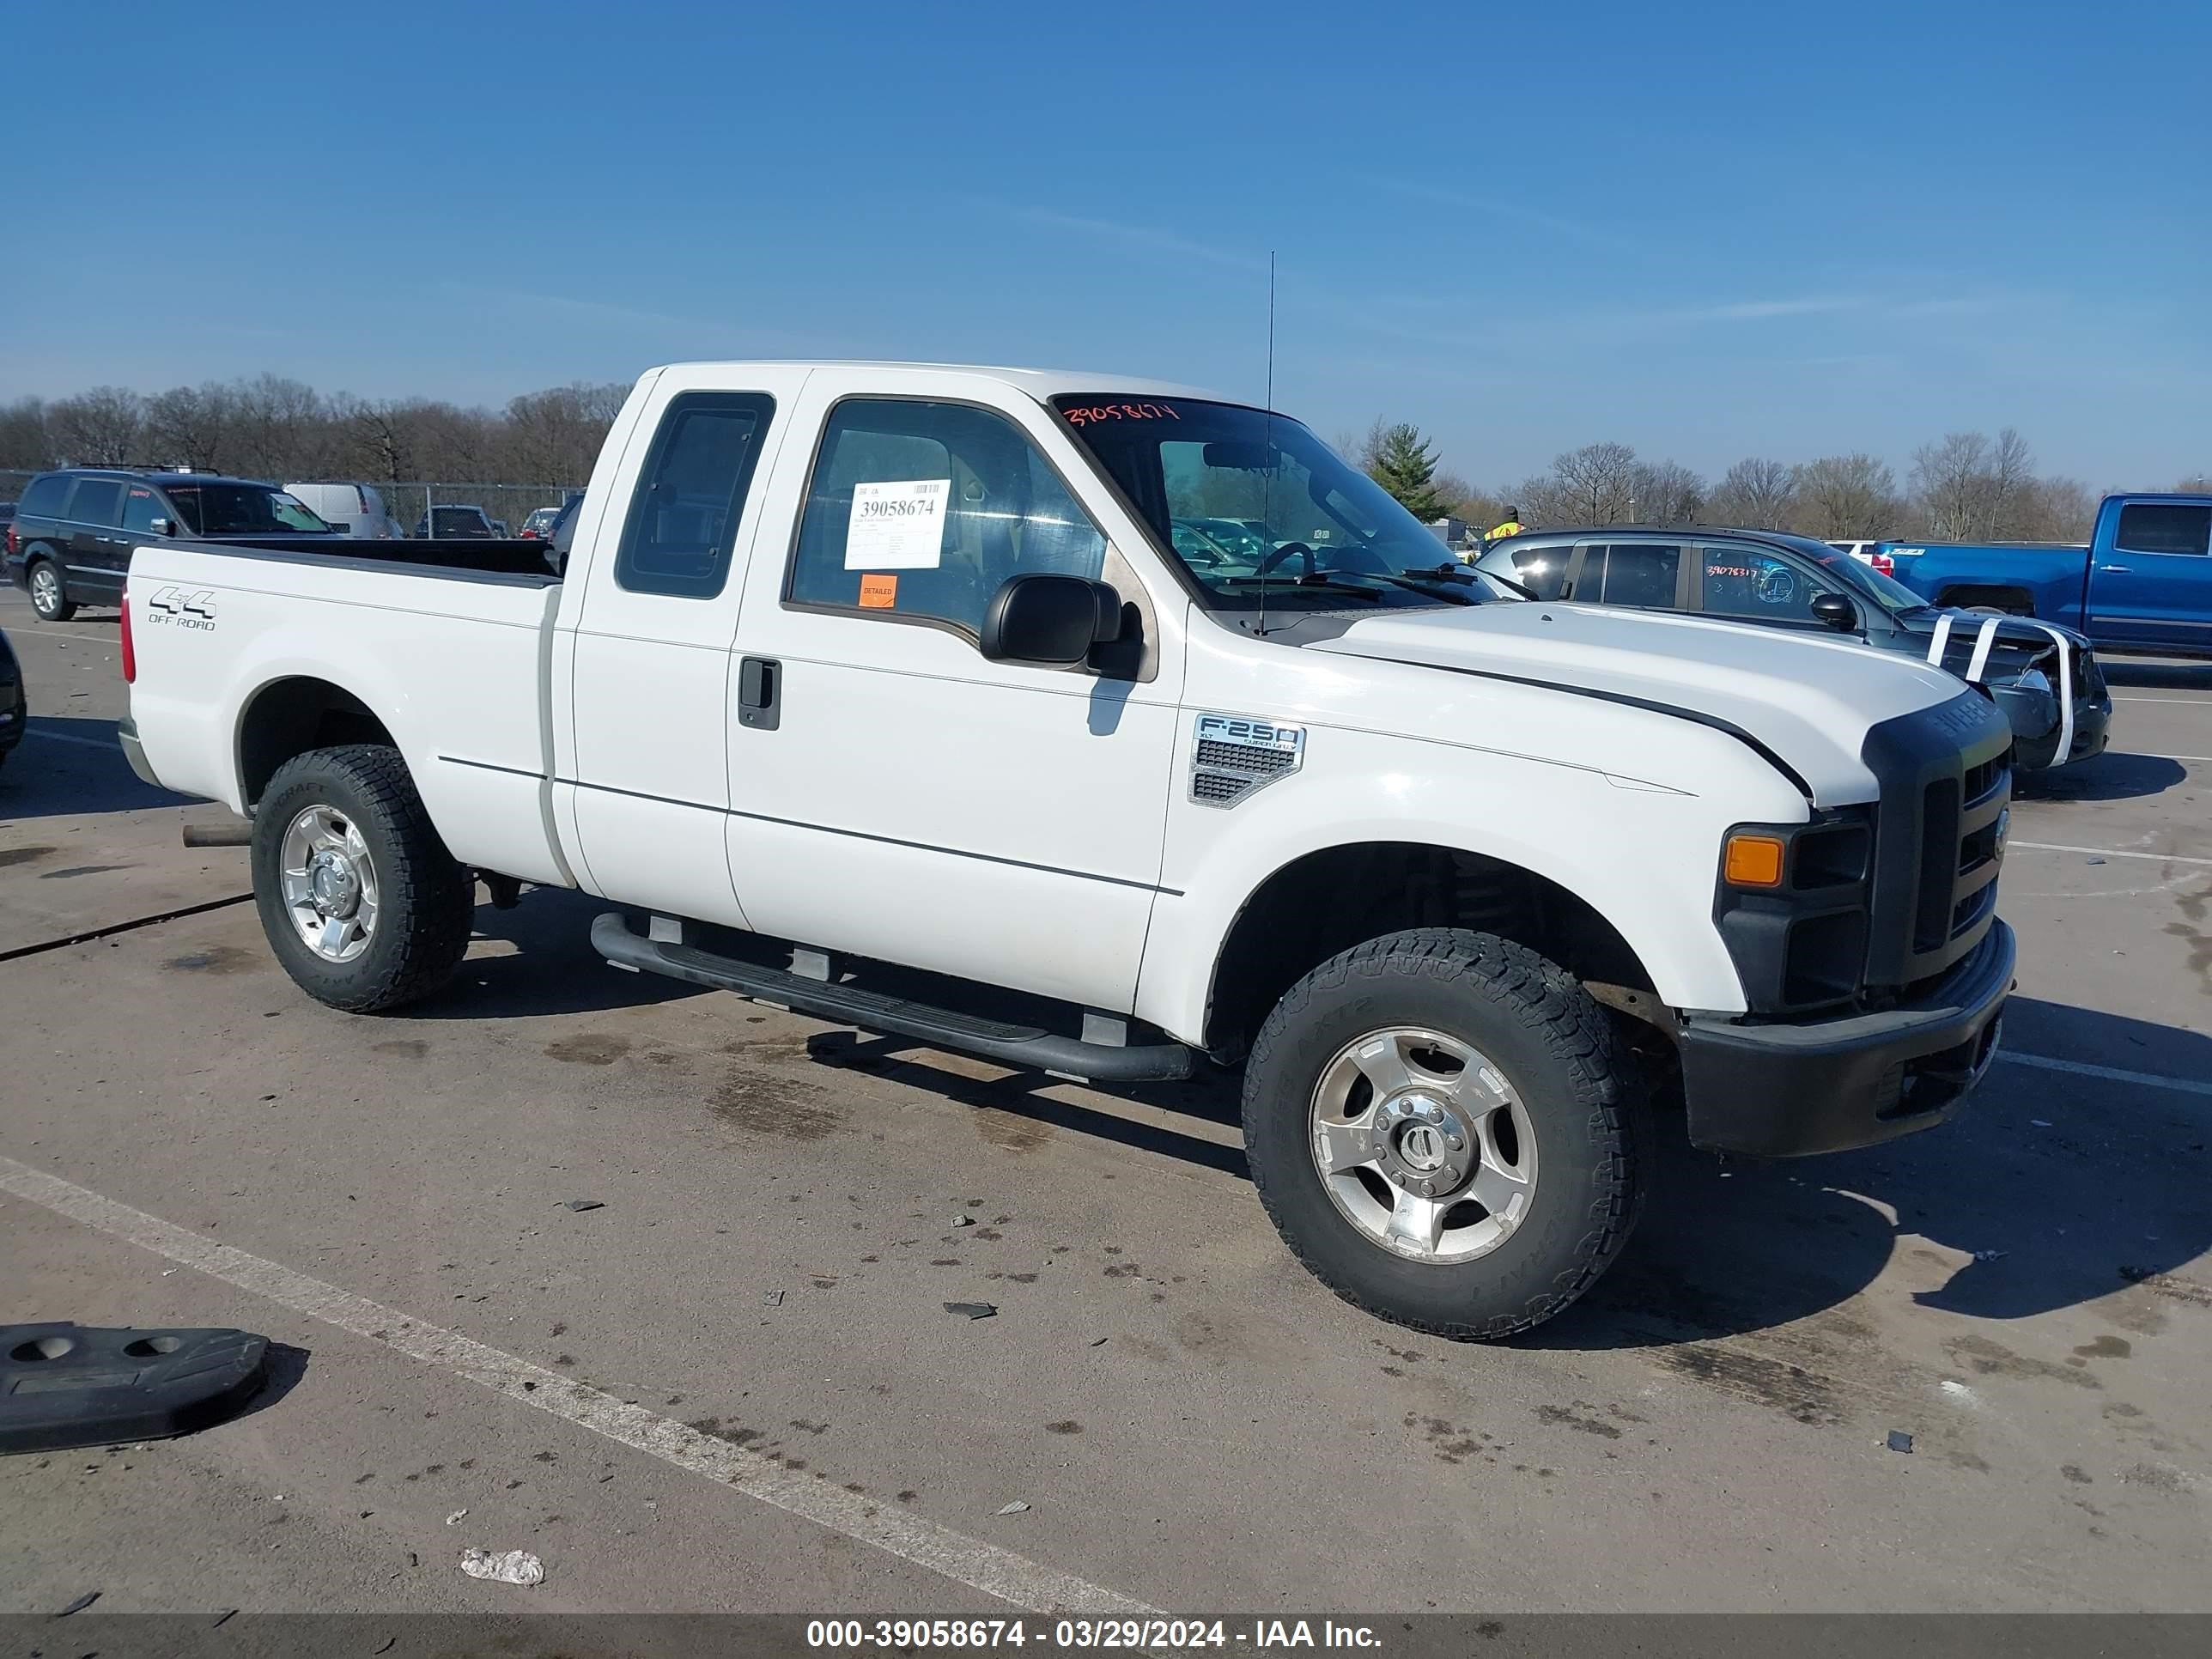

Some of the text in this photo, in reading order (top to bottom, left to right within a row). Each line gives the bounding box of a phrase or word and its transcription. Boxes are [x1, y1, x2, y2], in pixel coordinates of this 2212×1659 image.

[1063, 404, 1181, 427] 39058674
[860, 500, 935, 518] 39058674
[1706, 565, 1758, 577] 39078317
[149, 614, 216, 631] OFF ROAD
[1200, 718, 1299, 744] F-250
